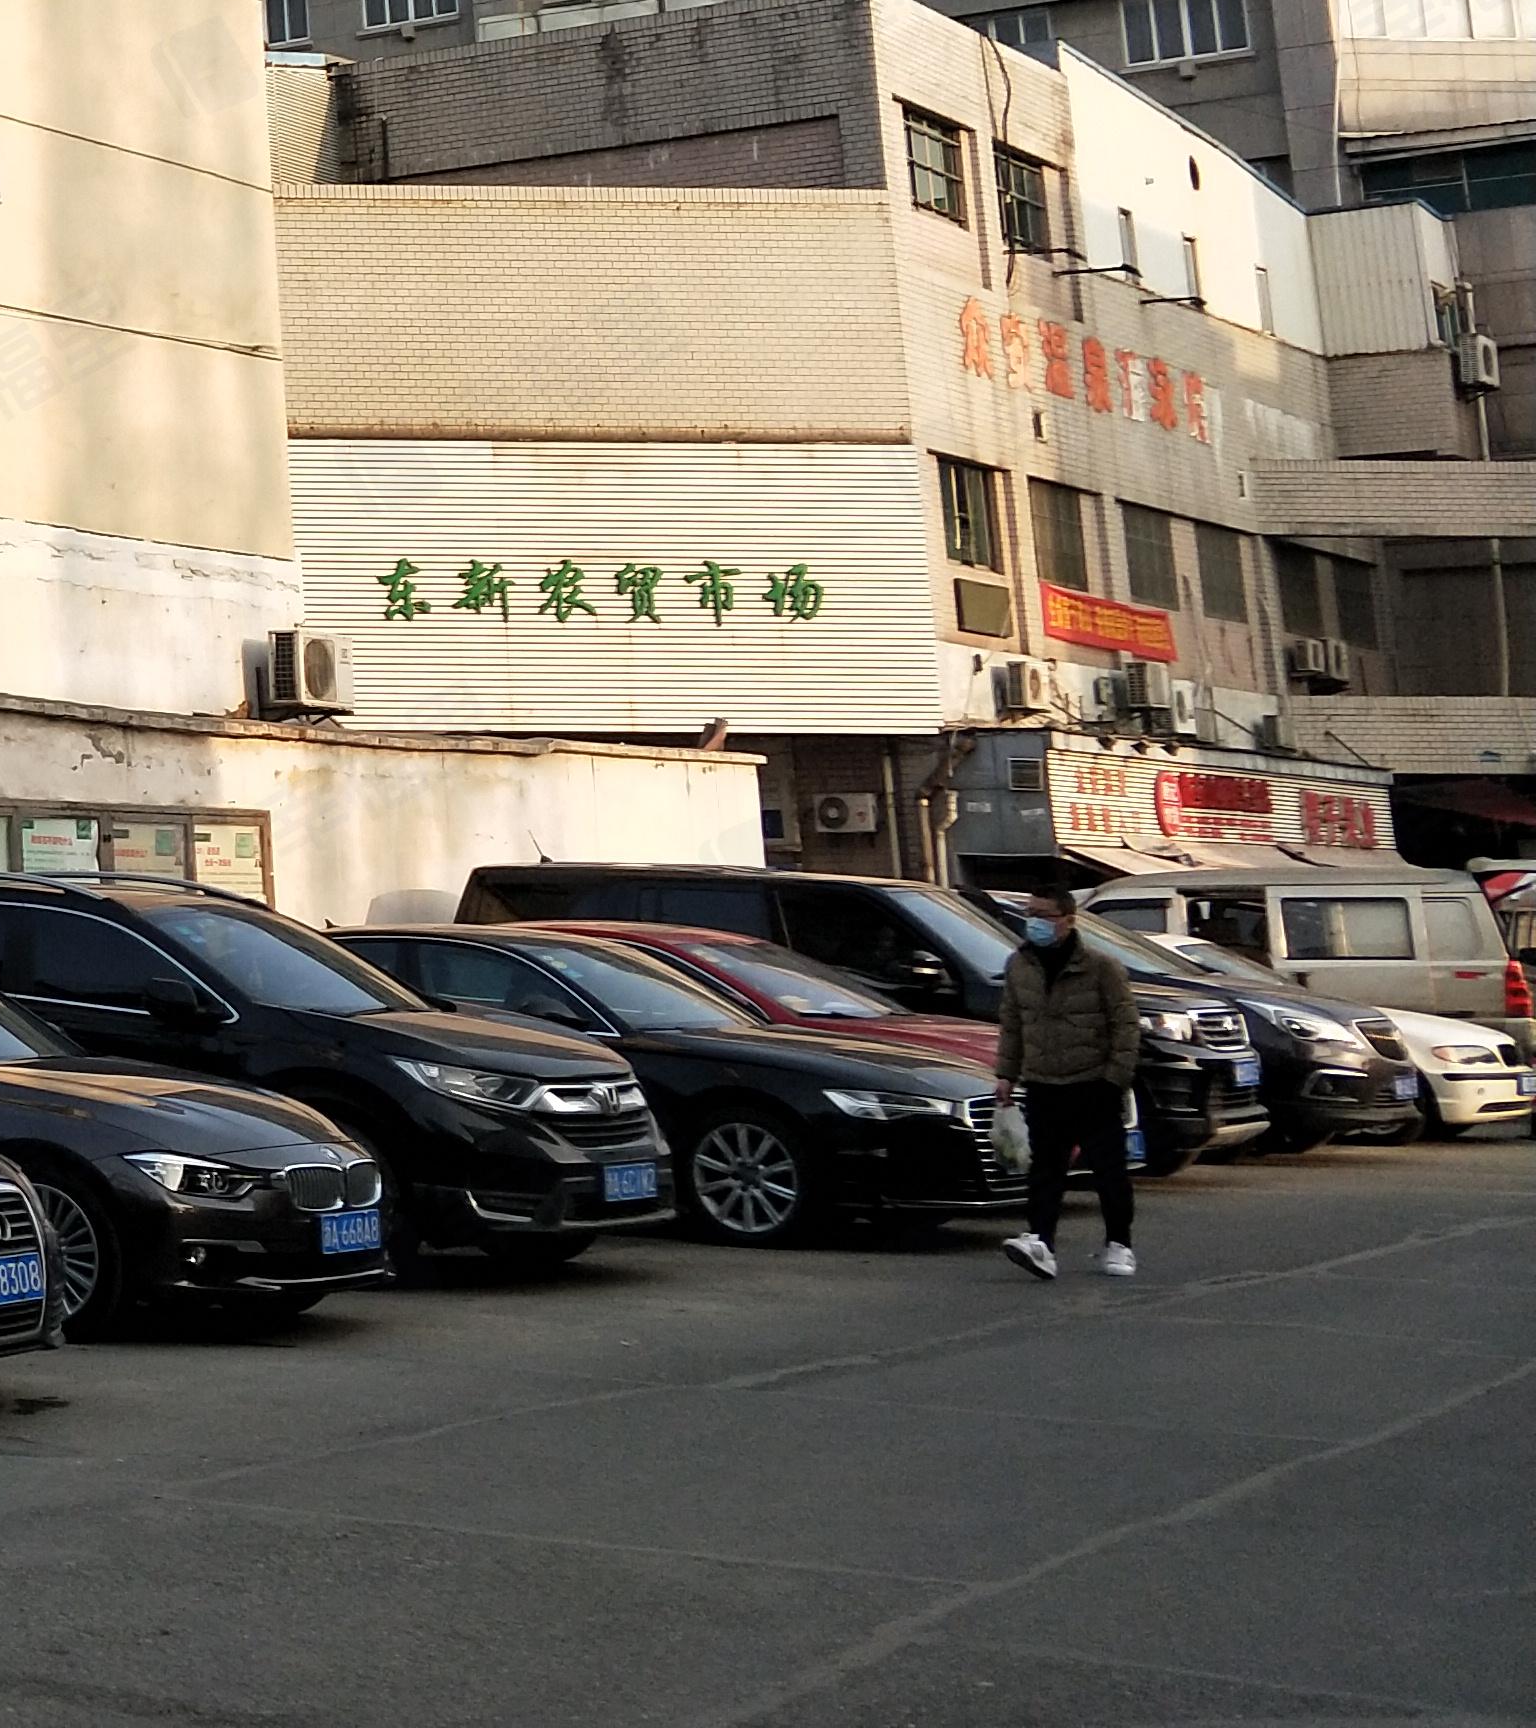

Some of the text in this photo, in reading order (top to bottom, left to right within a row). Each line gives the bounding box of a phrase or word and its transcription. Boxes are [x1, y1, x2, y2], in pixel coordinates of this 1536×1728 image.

[377, 557, 825, 626] 东新农贸市场
